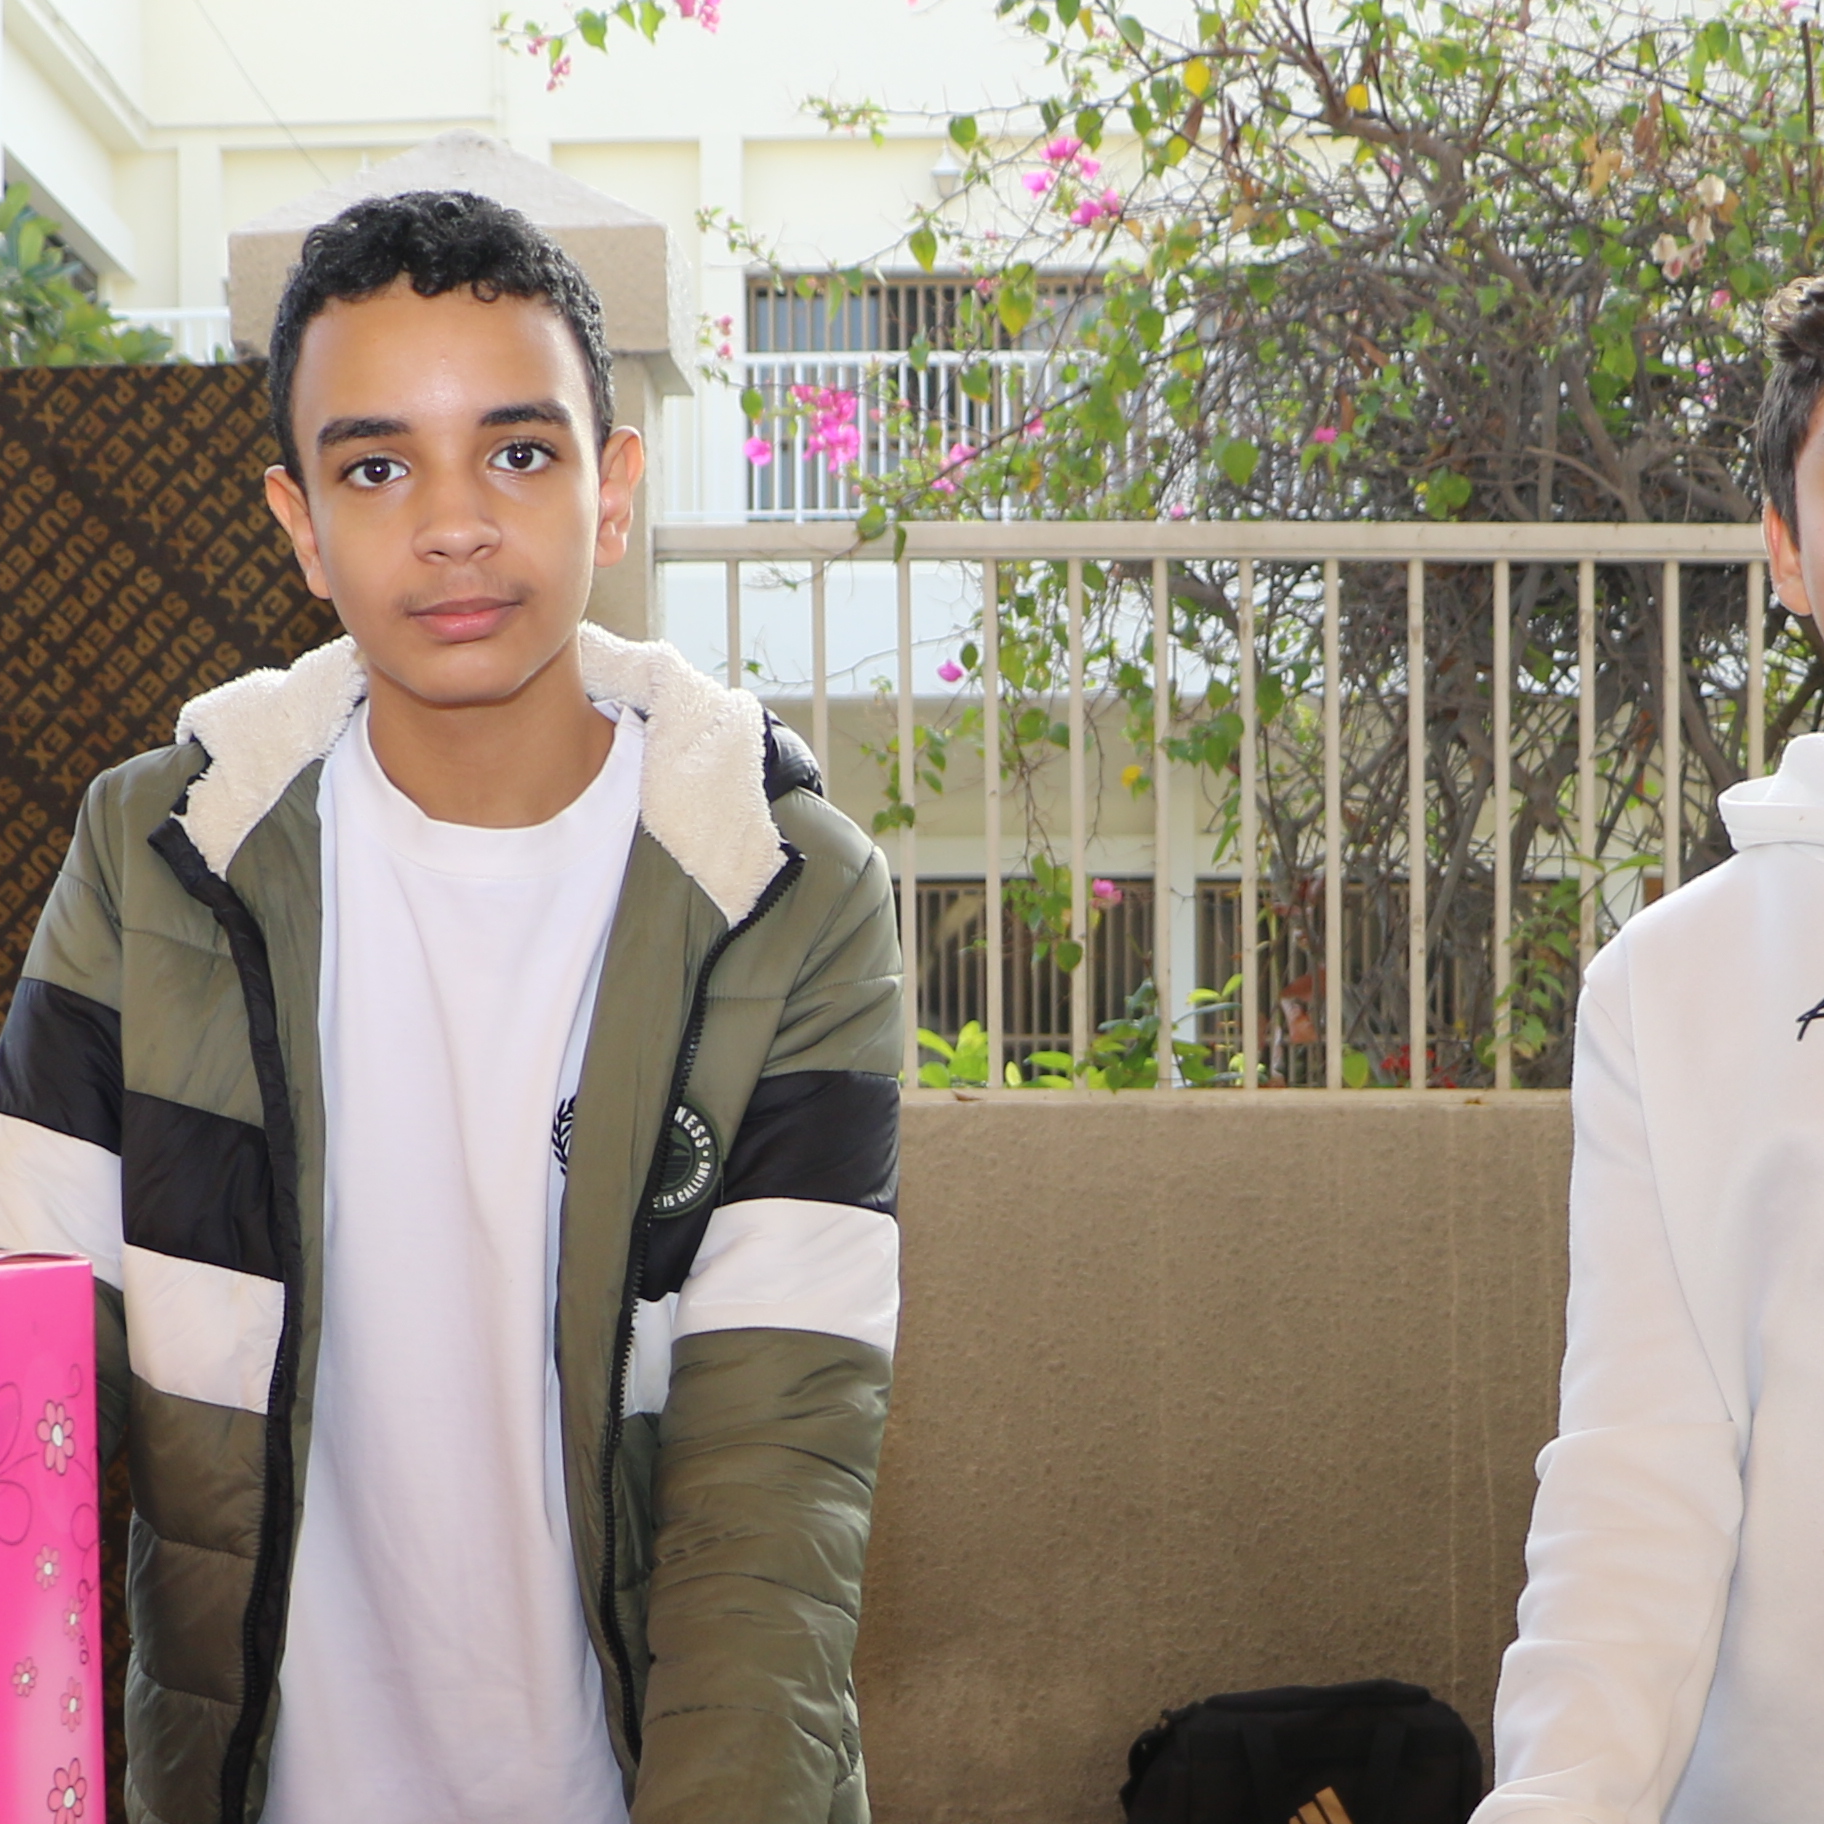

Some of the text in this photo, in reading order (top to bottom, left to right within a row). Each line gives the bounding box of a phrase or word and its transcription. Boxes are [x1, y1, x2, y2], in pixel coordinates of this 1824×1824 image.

[23, 587, 191, 772] SUPER-PLEX
[49, 612, 217, 797] SUPER-PLEX
[662, 1161, 712, 1208] IS CALLING
[674, 1105, 712, 1148] NESS
